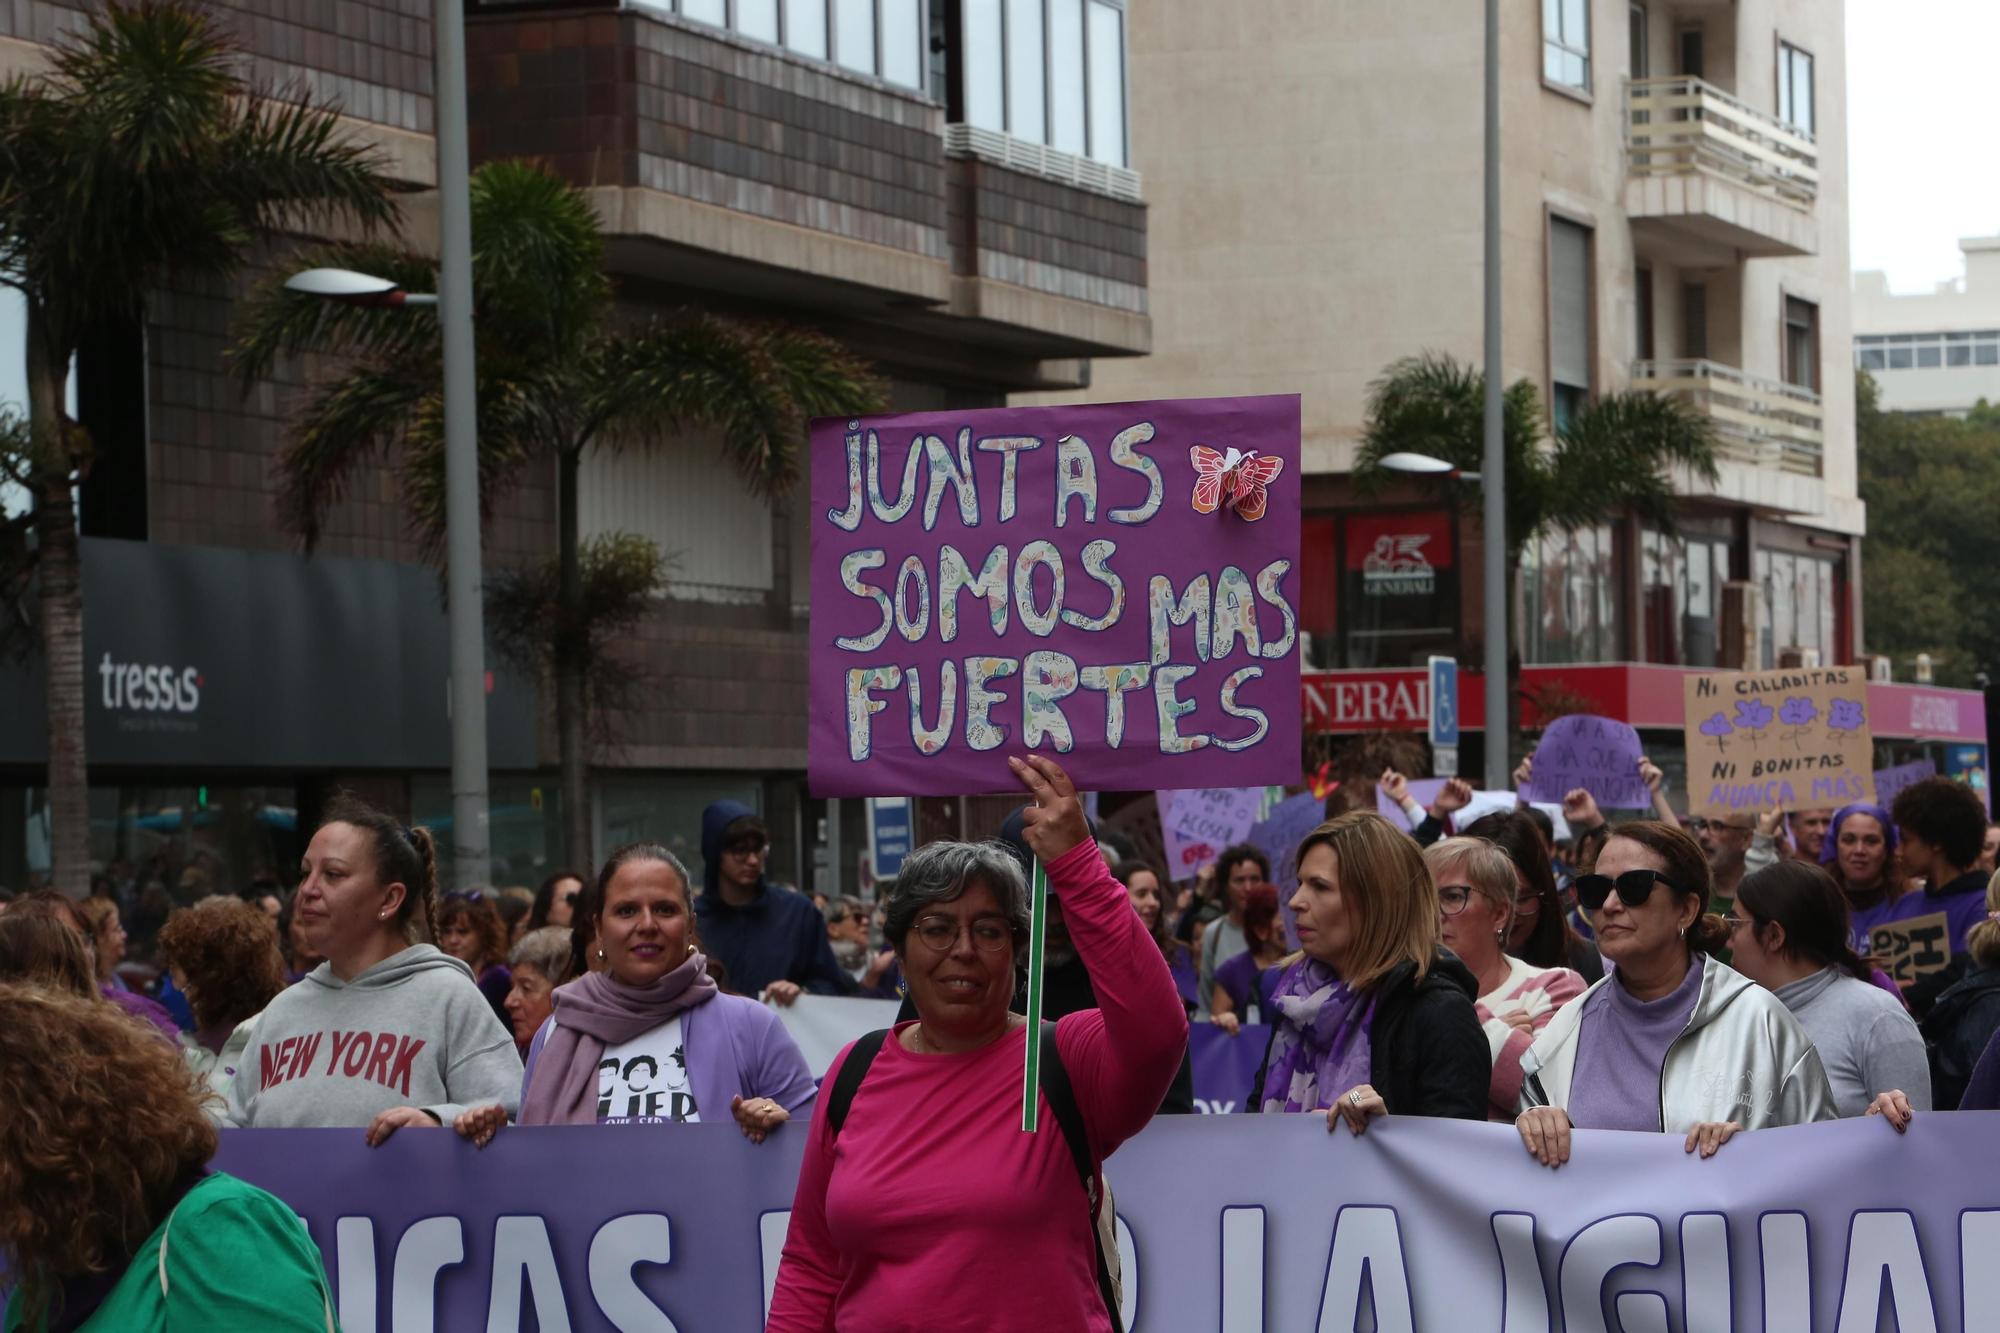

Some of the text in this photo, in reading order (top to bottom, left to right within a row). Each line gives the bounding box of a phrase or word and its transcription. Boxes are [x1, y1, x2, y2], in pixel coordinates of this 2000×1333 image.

[833, 538, 1297, 666] SOMOS MAS
[1363, 579, 1436, 595] GENERALI
[1301, 678, 1430, 724] NERAL
[1735, 671, 1850, 694] CALLADITAS
[844, 650, 1270, 762] FUERTES
[1711, 754, 1845, 780] NI BONITAS
[1707, 769, 1865, 808] NUNCA MÁS
[260, 1031, 426, 1099] NEW YORK
